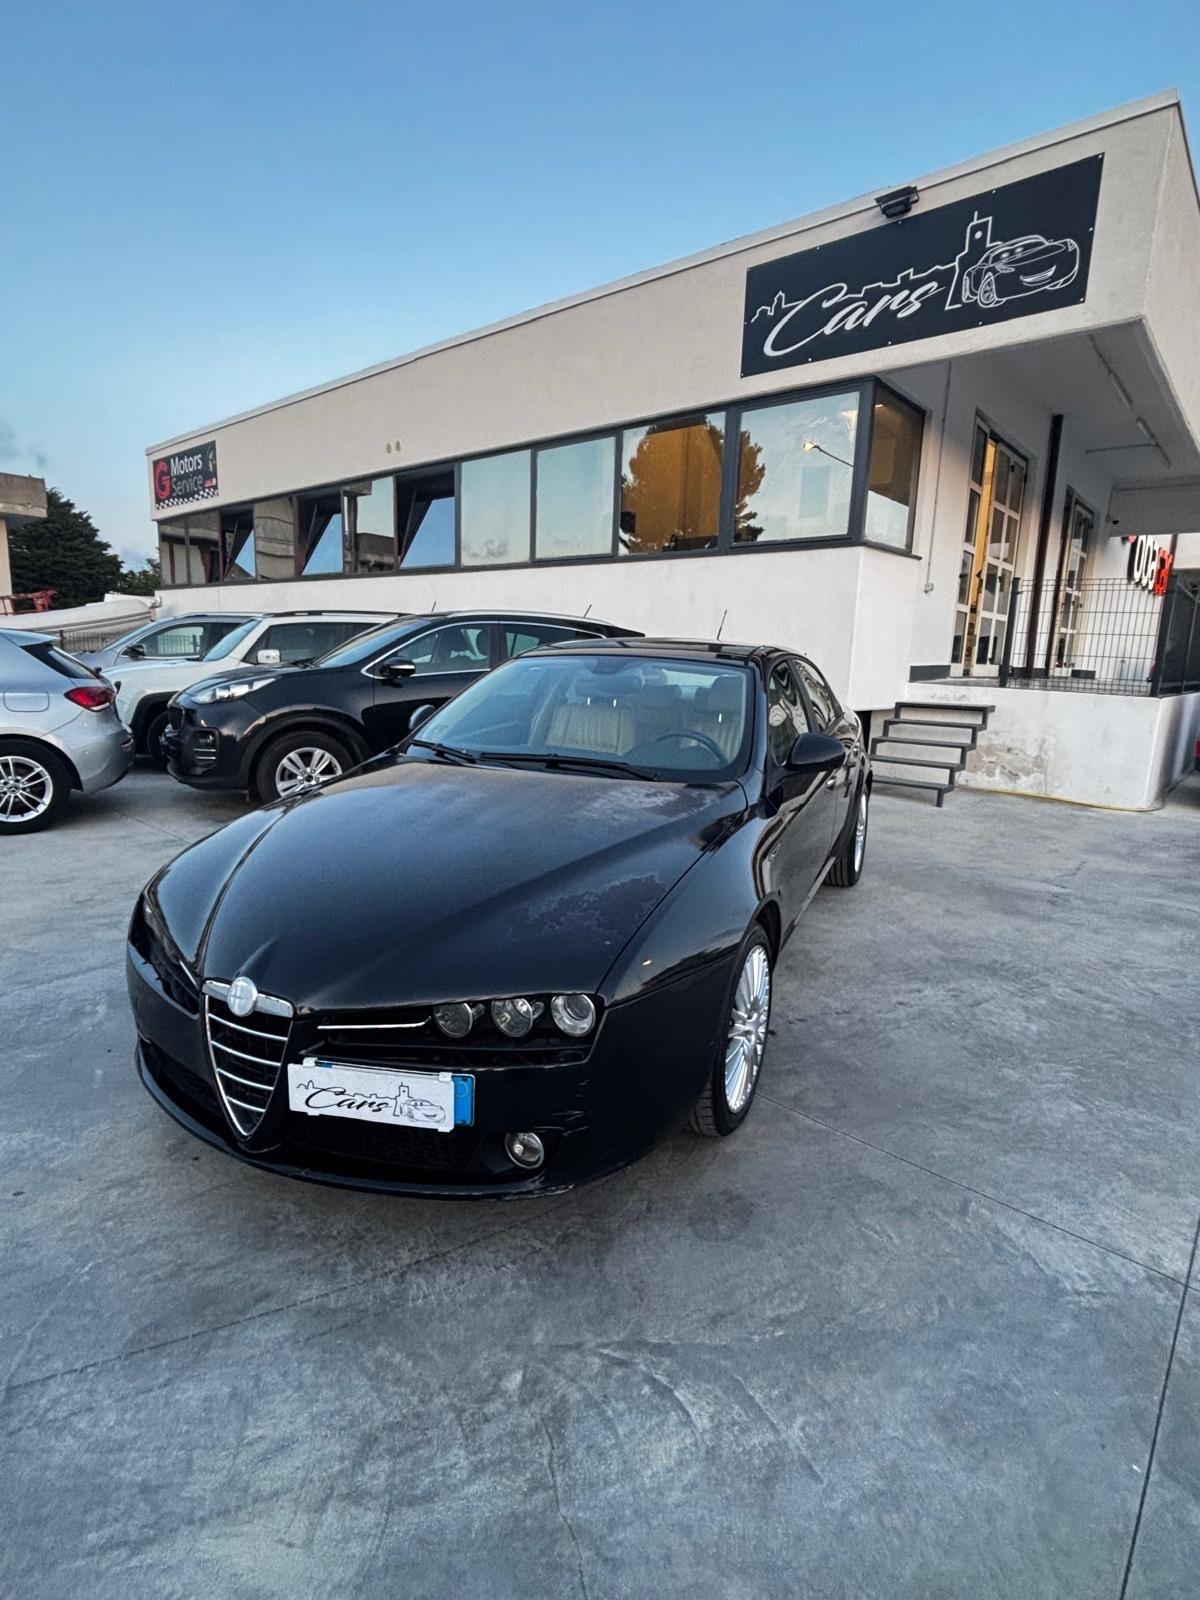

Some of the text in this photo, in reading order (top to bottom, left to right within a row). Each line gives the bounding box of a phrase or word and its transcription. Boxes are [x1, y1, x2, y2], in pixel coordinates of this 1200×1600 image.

[763, 281, 946, 356] Cars
[155, 454, 203, 500] G Motors
[171, 475, 203, 497] Service
[305, 1086, 393, 1113] Cars
